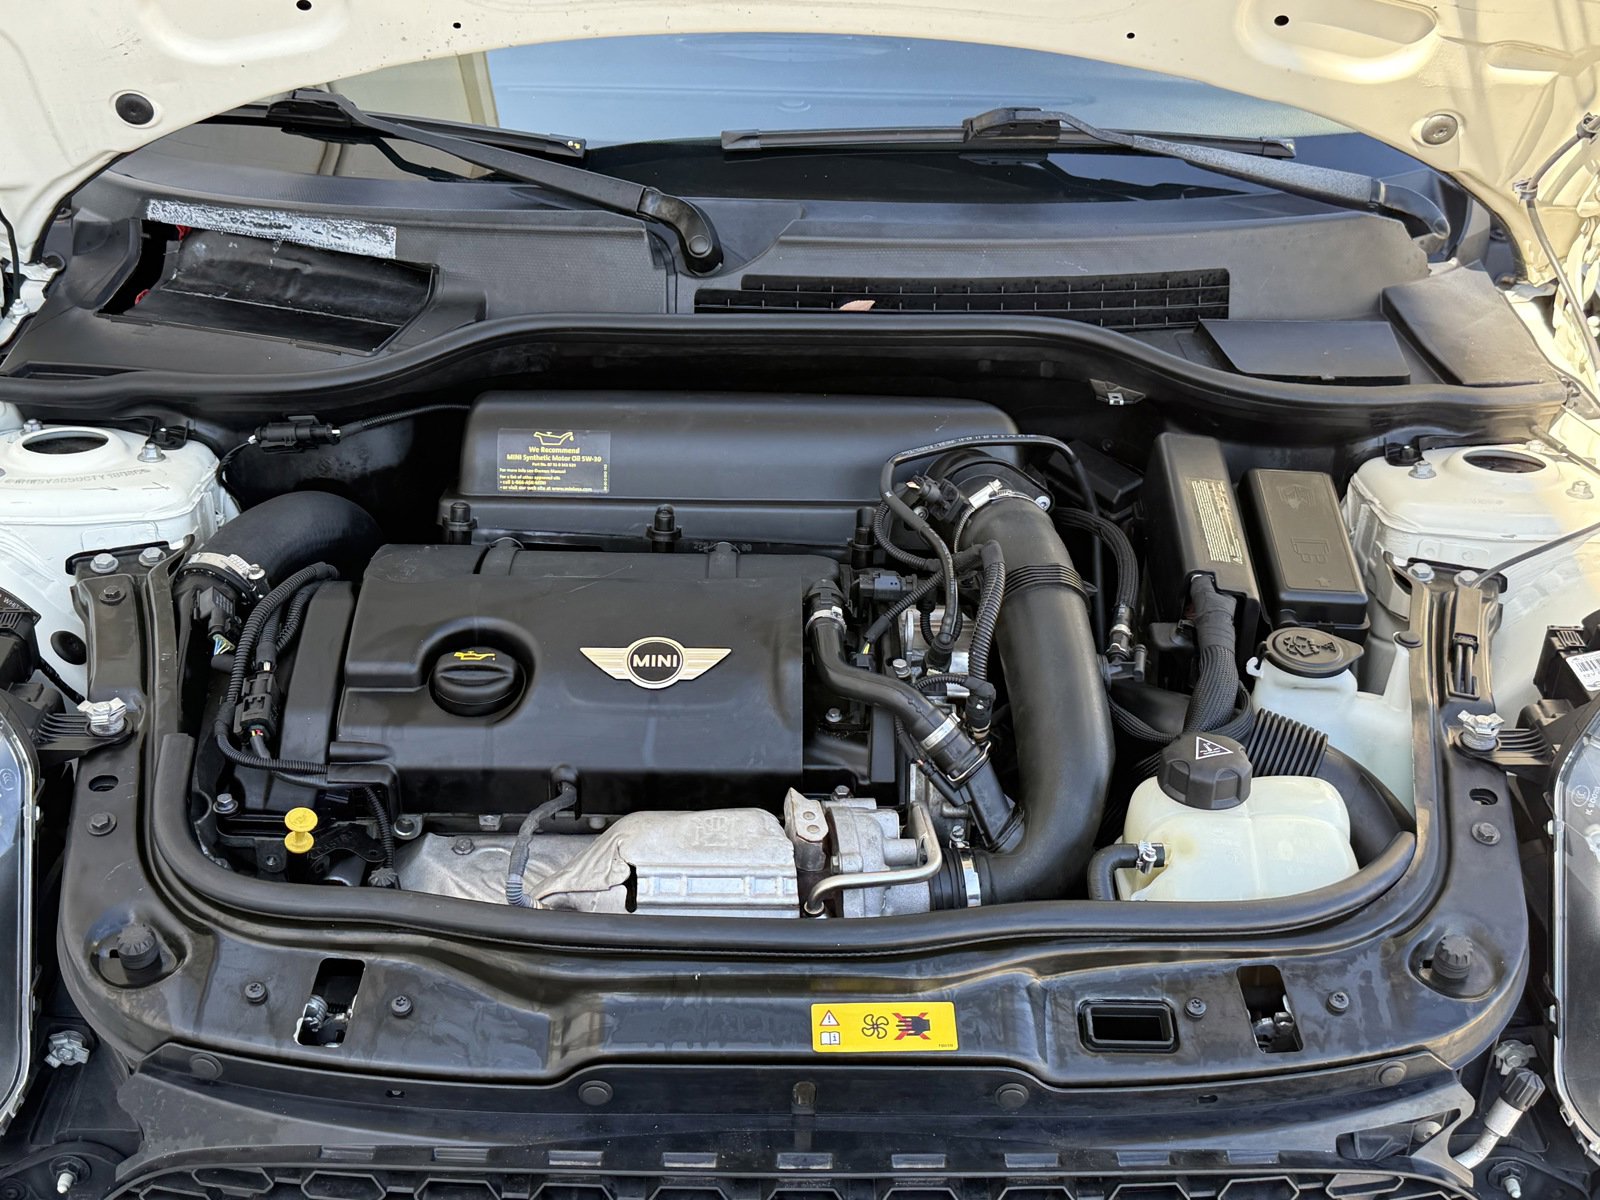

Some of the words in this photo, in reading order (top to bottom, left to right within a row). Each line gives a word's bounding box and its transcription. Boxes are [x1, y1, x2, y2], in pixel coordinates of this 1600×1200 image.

[541, 446, 580, 454] Recommend
[523, 454, 551, 462] Synthetic
[633, 654, 678, 668] MINI
